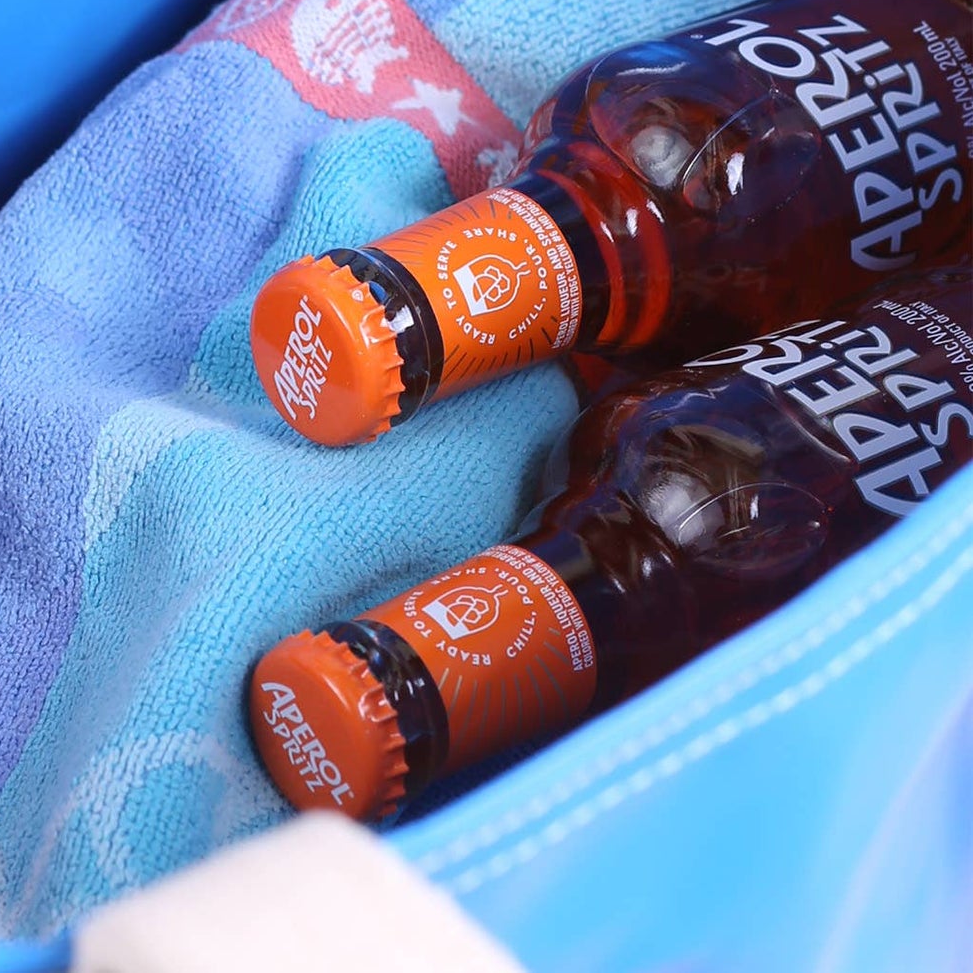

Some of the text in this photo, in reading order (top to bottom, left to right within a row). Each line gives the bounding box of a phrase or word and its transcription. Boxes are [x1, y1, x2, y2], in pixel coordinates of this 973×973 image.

[704, 18, 923, 272] APEROL
[462, 227, 517, 242] SHARE
[508, 201, 552, 247] SPARKLING
[537, 215, 554, 230] AND
[546, 247, 564, 270] AND
[555, 243, 575, 276] YELLOW
[436, 240, 496, 344] READY TO SERVE
[556, 271, 571, 317] LIQUEUR
[570, 298, 580, 319] WITH
[908, 300, 973, 356] ODUCT OF ITALY
[917, 321, 971, 364] Alc/Vol
[273, 295, 322, 420] APEROL
[522, 567, 545, 585] AND
[531, 562, 560, 587] YELLOW
[540, 584, 573, 630] LIQUEUR
[567, 606, 584, 631] WITH
[413, 620, 432, 638] TO
[435, 640, 492, 666] READY
[565, 628, 584, 672] APEROL
[577, 630, 594, 668] COLORED
[260, 682, 351, 806] APEROL
